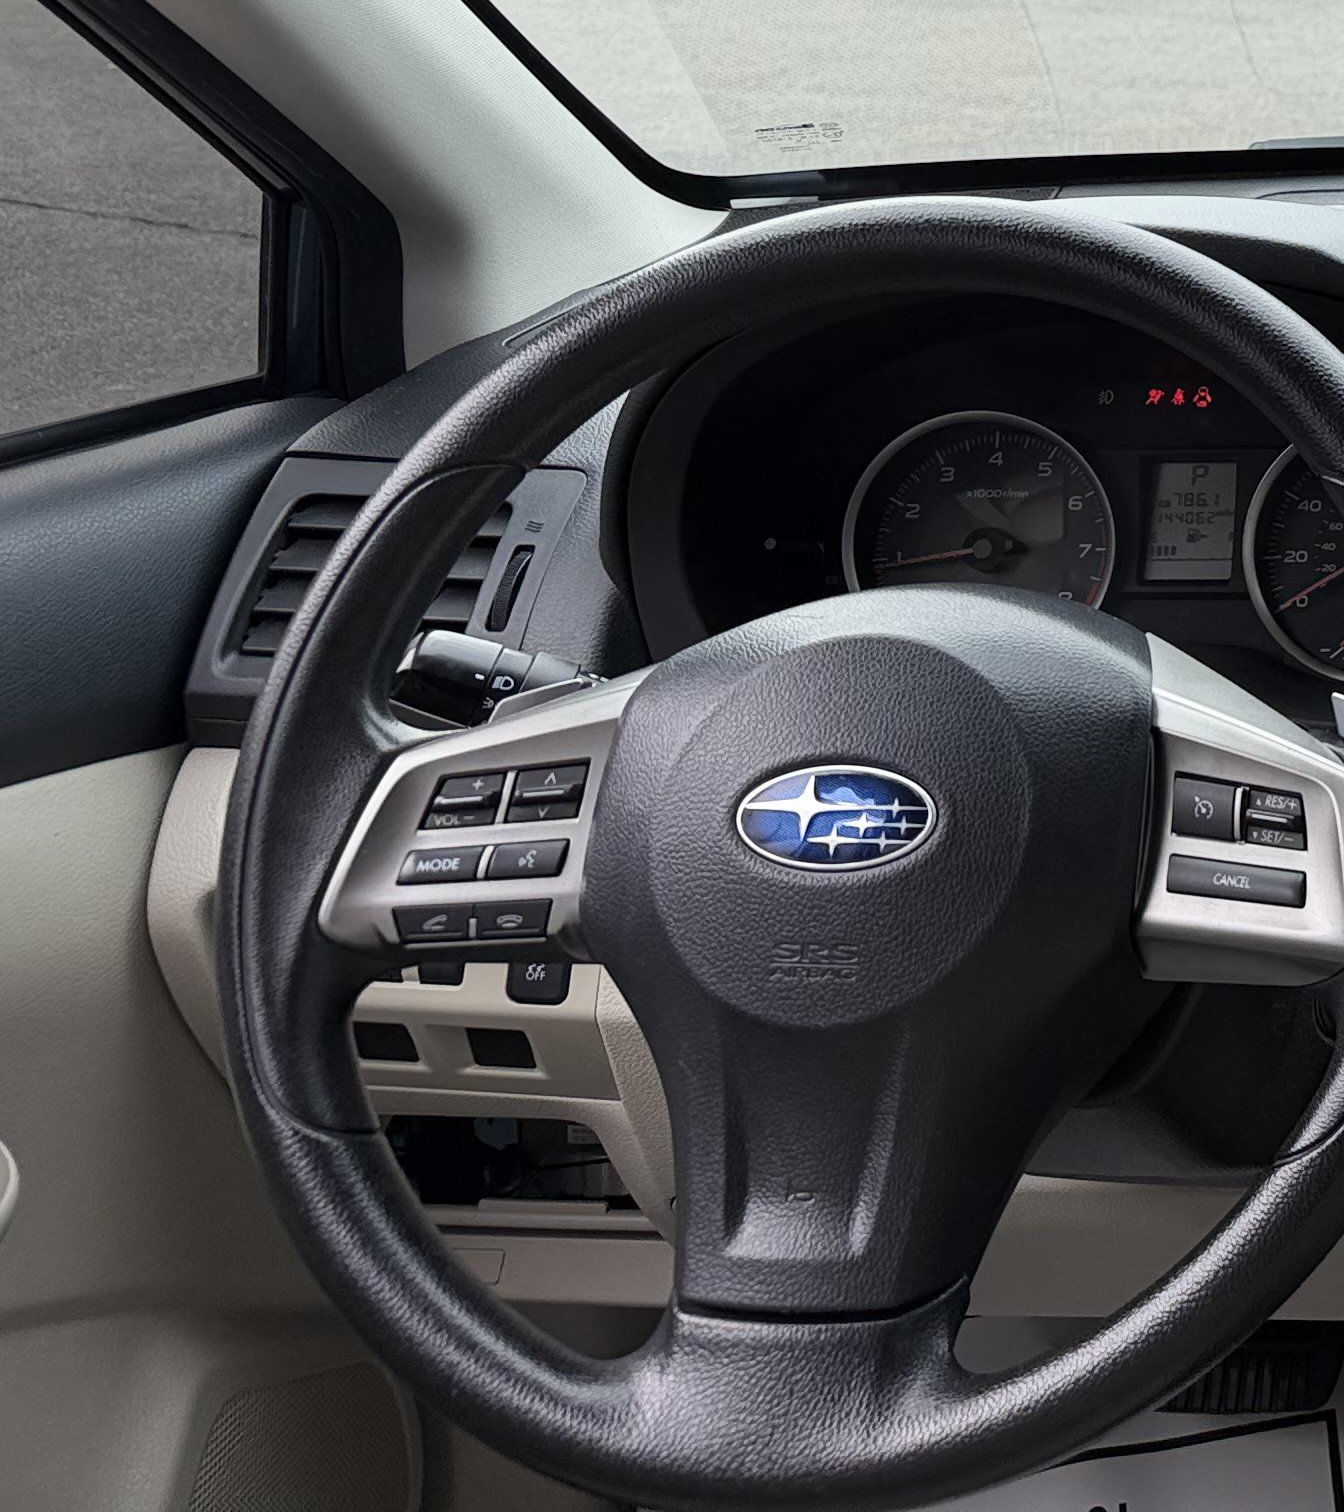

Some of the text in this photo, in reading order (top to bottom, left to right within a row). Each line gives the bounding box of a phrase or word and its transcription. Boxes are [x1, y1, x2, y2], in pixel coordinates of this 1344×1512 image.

[988, 451, 1004, 466] 4
[940, 466, 955, 482] 3
[1037, 461, 1053, 477] 5
[1192, 465, 1209, 486] P
[1068, 495, 1083, 510] 6
[1298, 499, 1322, 512] 40
[905, 503, 921, 519] 2
[1078, 543, 1093, 558] 7
[1284, 551, 1308, 564] 20
[433, 814, 461, 826] VOL
[416, 857, 461, 872] MODE
[1213, 872, 1250, 889] CANCEL
[526, 971, 547, 981] OFF
